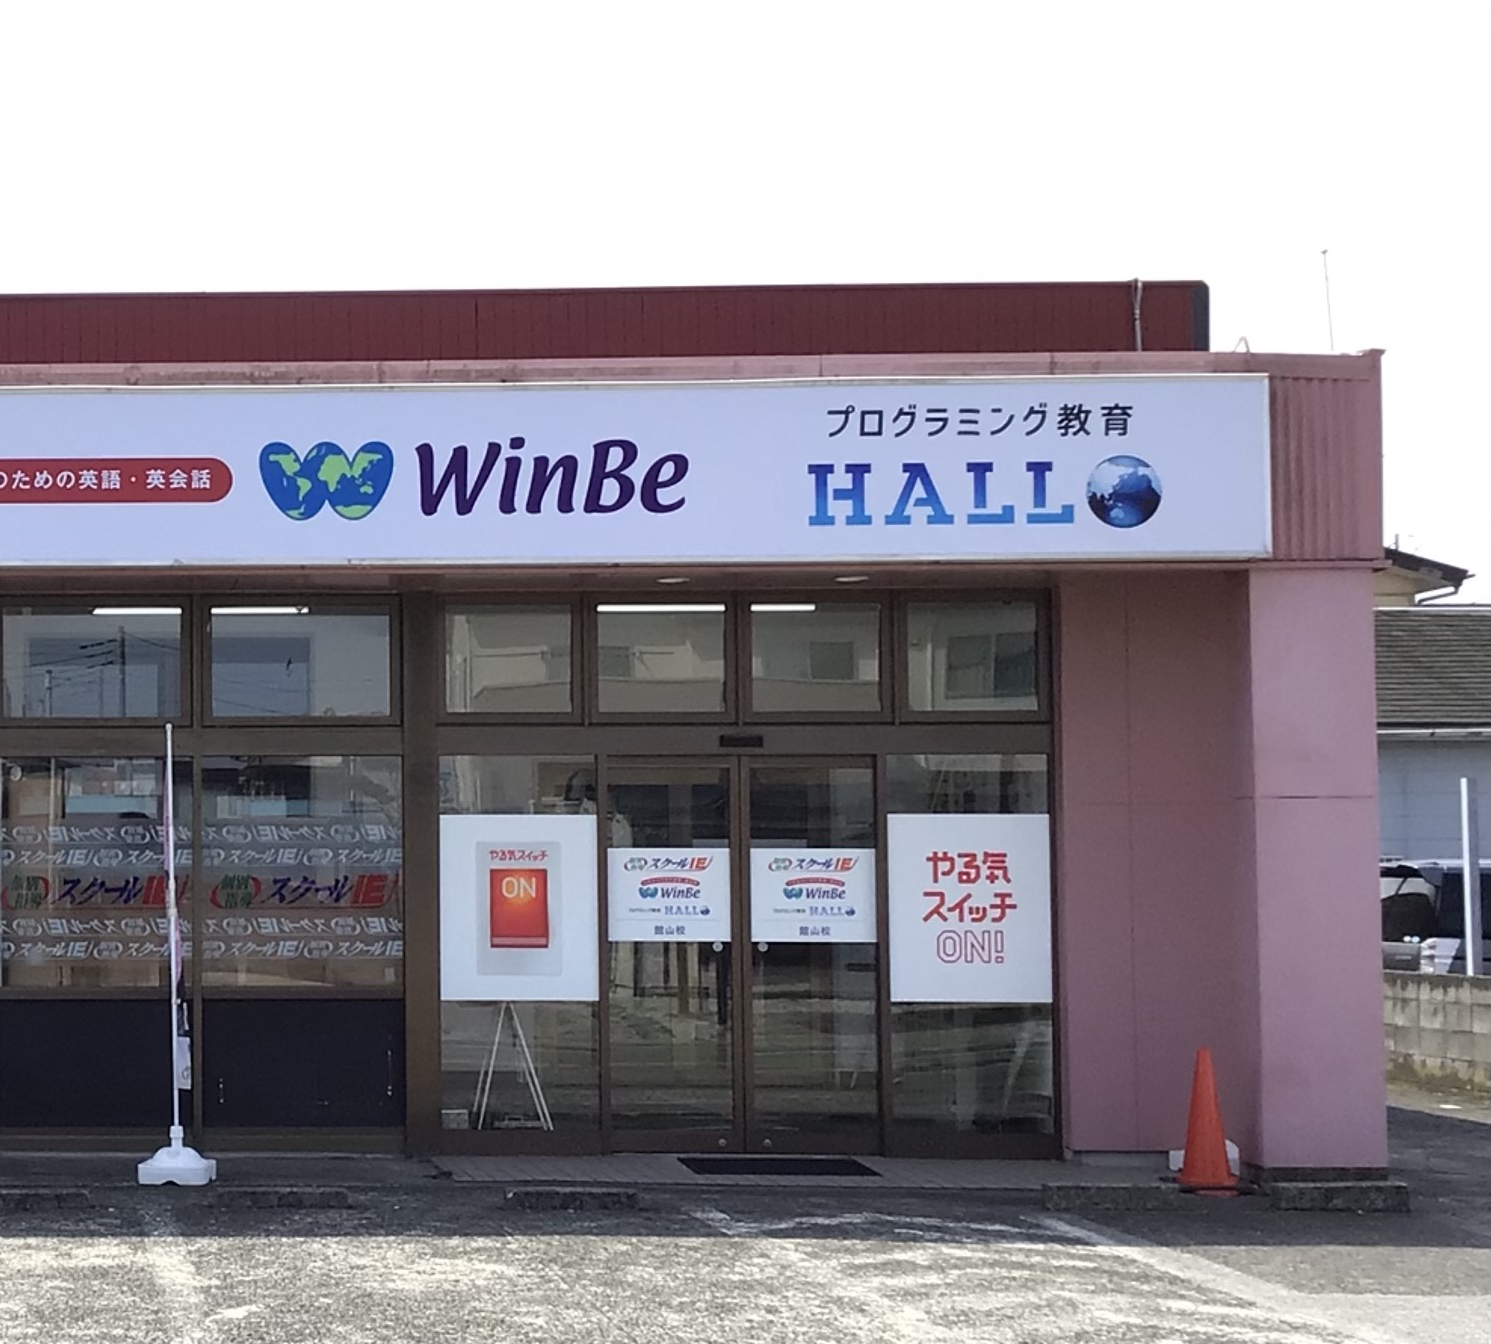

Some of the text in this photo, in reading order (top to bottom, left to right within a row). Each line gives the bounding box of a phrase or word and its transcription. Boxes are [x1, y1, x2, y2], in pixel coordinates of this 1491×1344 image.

[825, 402, 1134, 438] プログラミング教育
[415, 436, 690, 517] WinBe
[488, 849, 549, 861] やる気スイッチ
[925, 850, 1012, 884] やる気
[501, 876, 537, 899] ON
[660, 886, 701, 899] WinBe
[805, 887, 846, 900] WinBe
[922, 891, 1018, 923] スイッチ
[936, 929, 1005, 964] ON!
